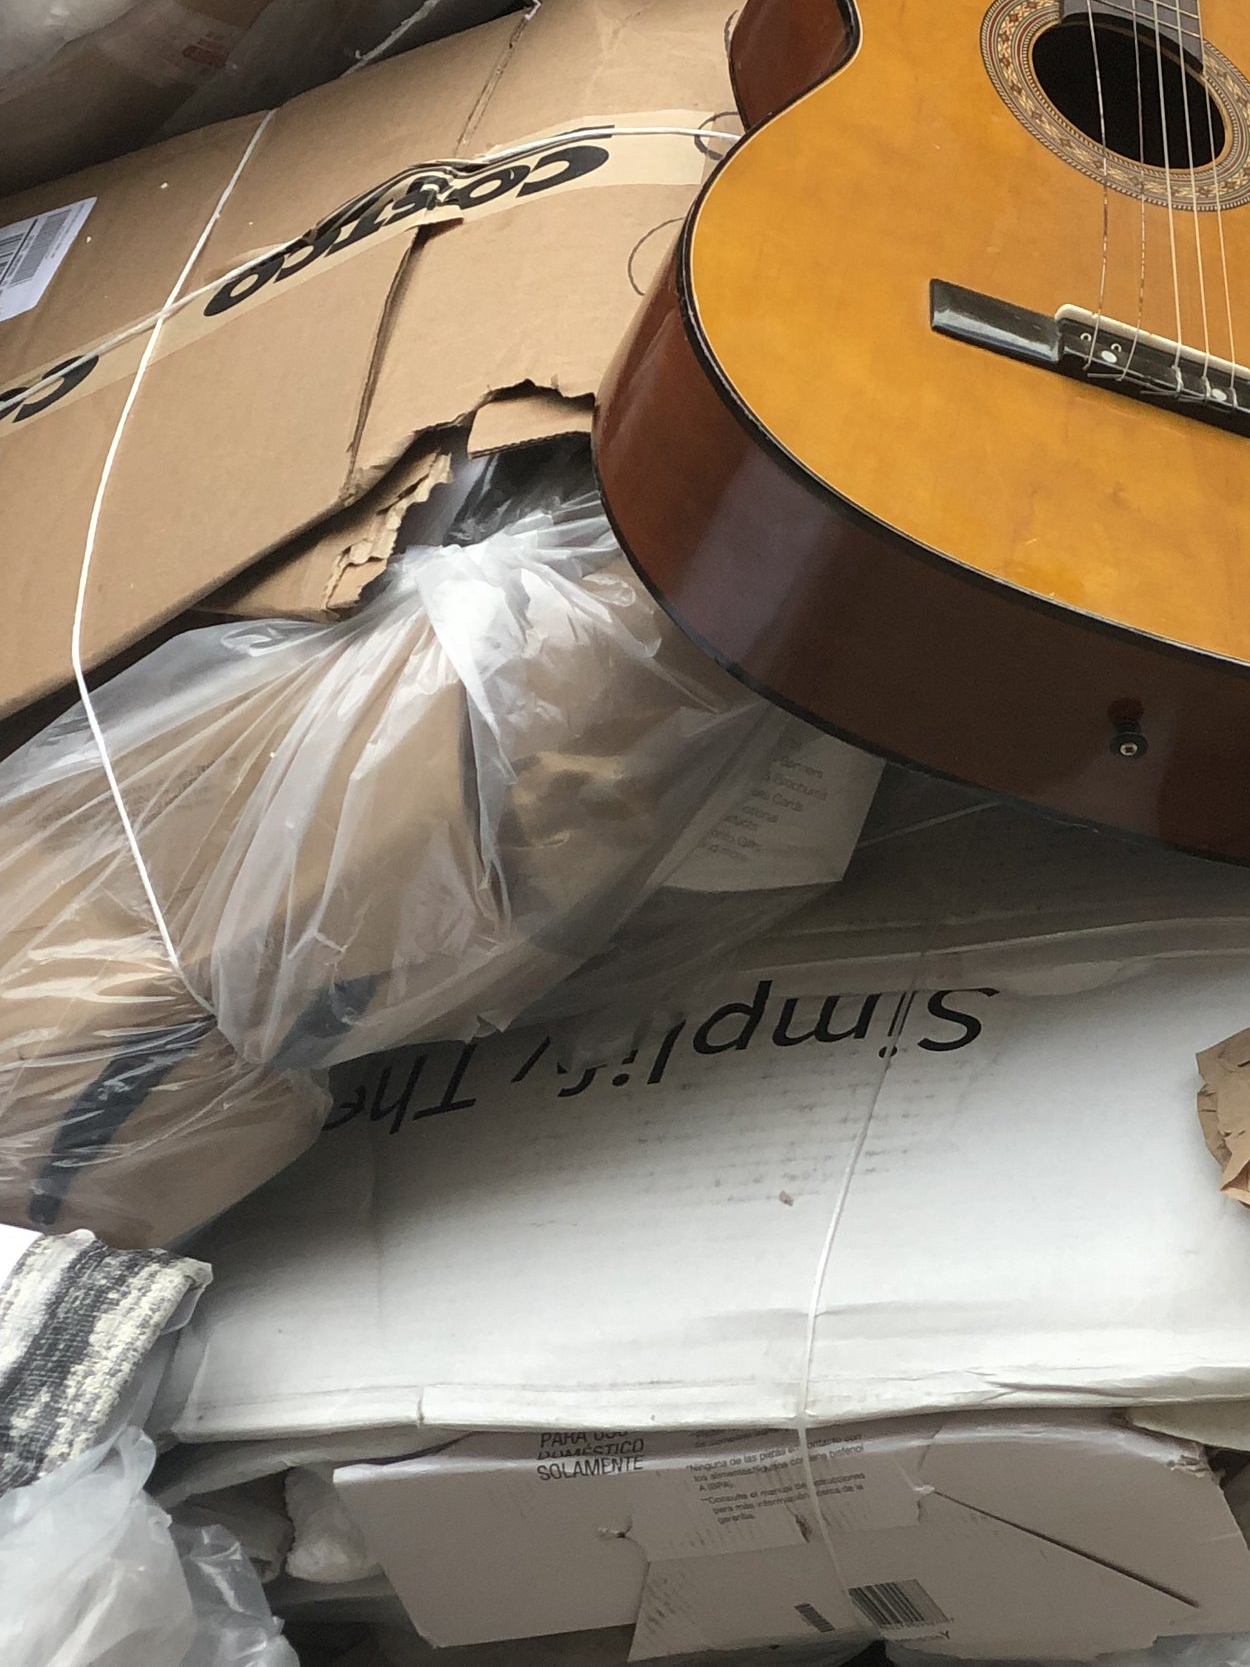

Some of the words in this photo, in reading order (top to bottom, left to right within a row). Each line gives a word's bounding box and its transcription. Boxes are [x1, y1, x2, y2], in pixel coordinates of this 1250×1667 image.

[203, 145, 610, 316] COSTCO
[537, 1455, 645, 1481] SOLAMENTE
[744, 1452, 758, 1464] las
